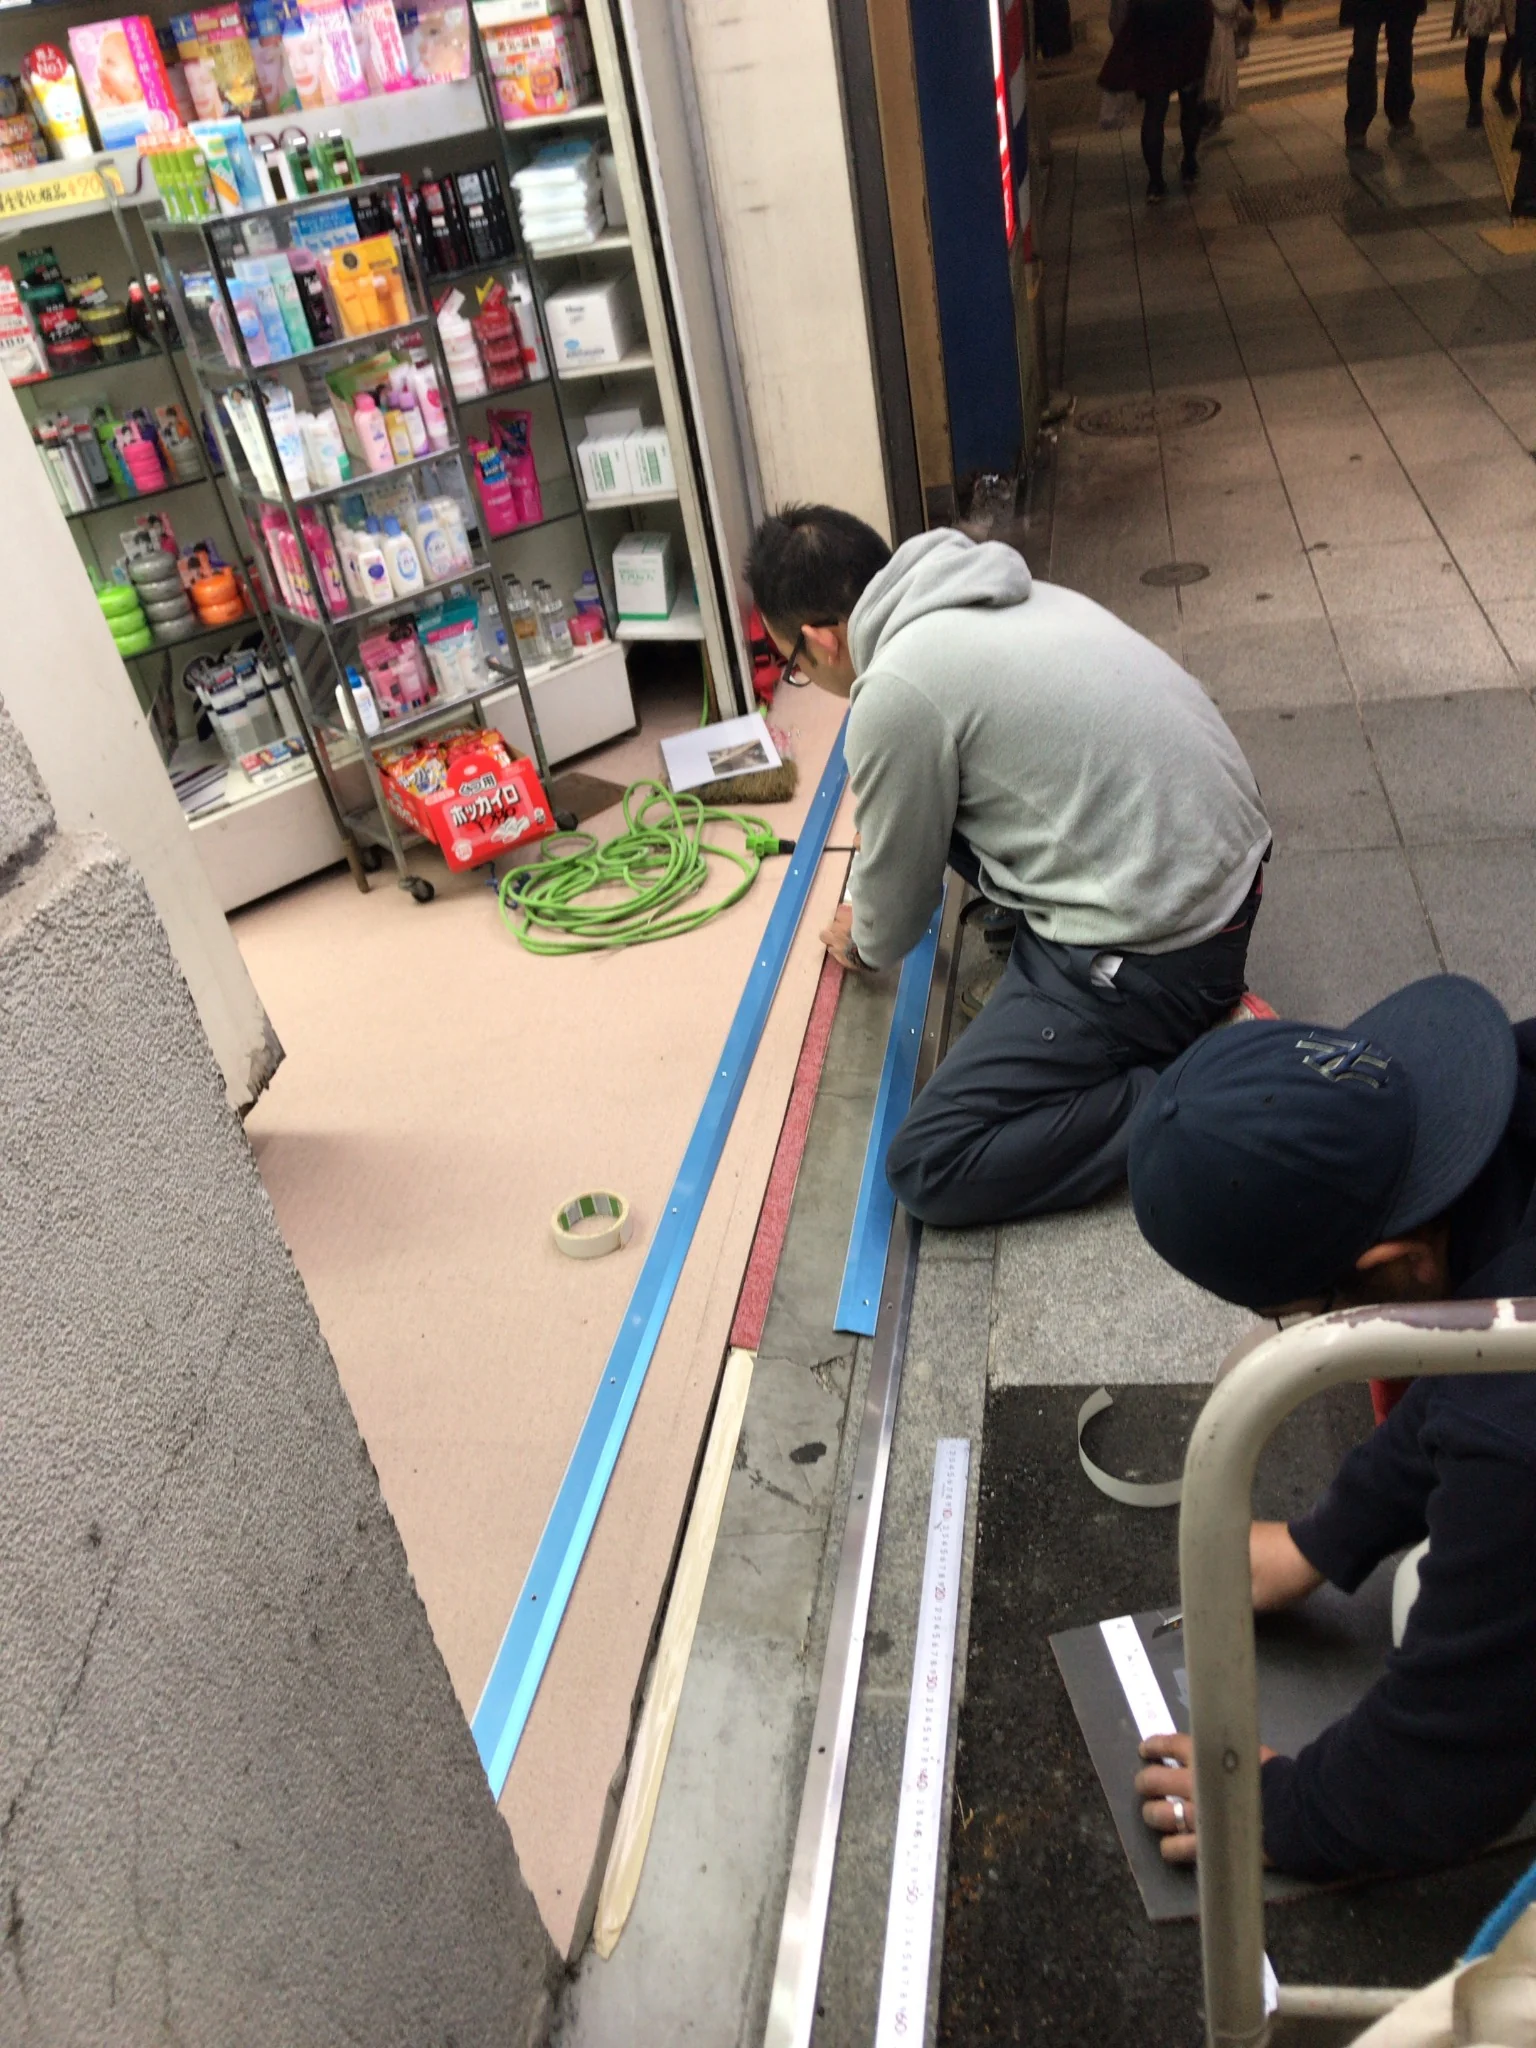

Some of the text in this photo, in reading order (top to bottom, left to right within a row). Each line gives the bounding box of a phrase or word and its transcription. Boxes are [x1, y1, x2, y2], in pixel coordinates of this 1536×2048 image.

[450, 784, 519, 827] ホッカイロ
